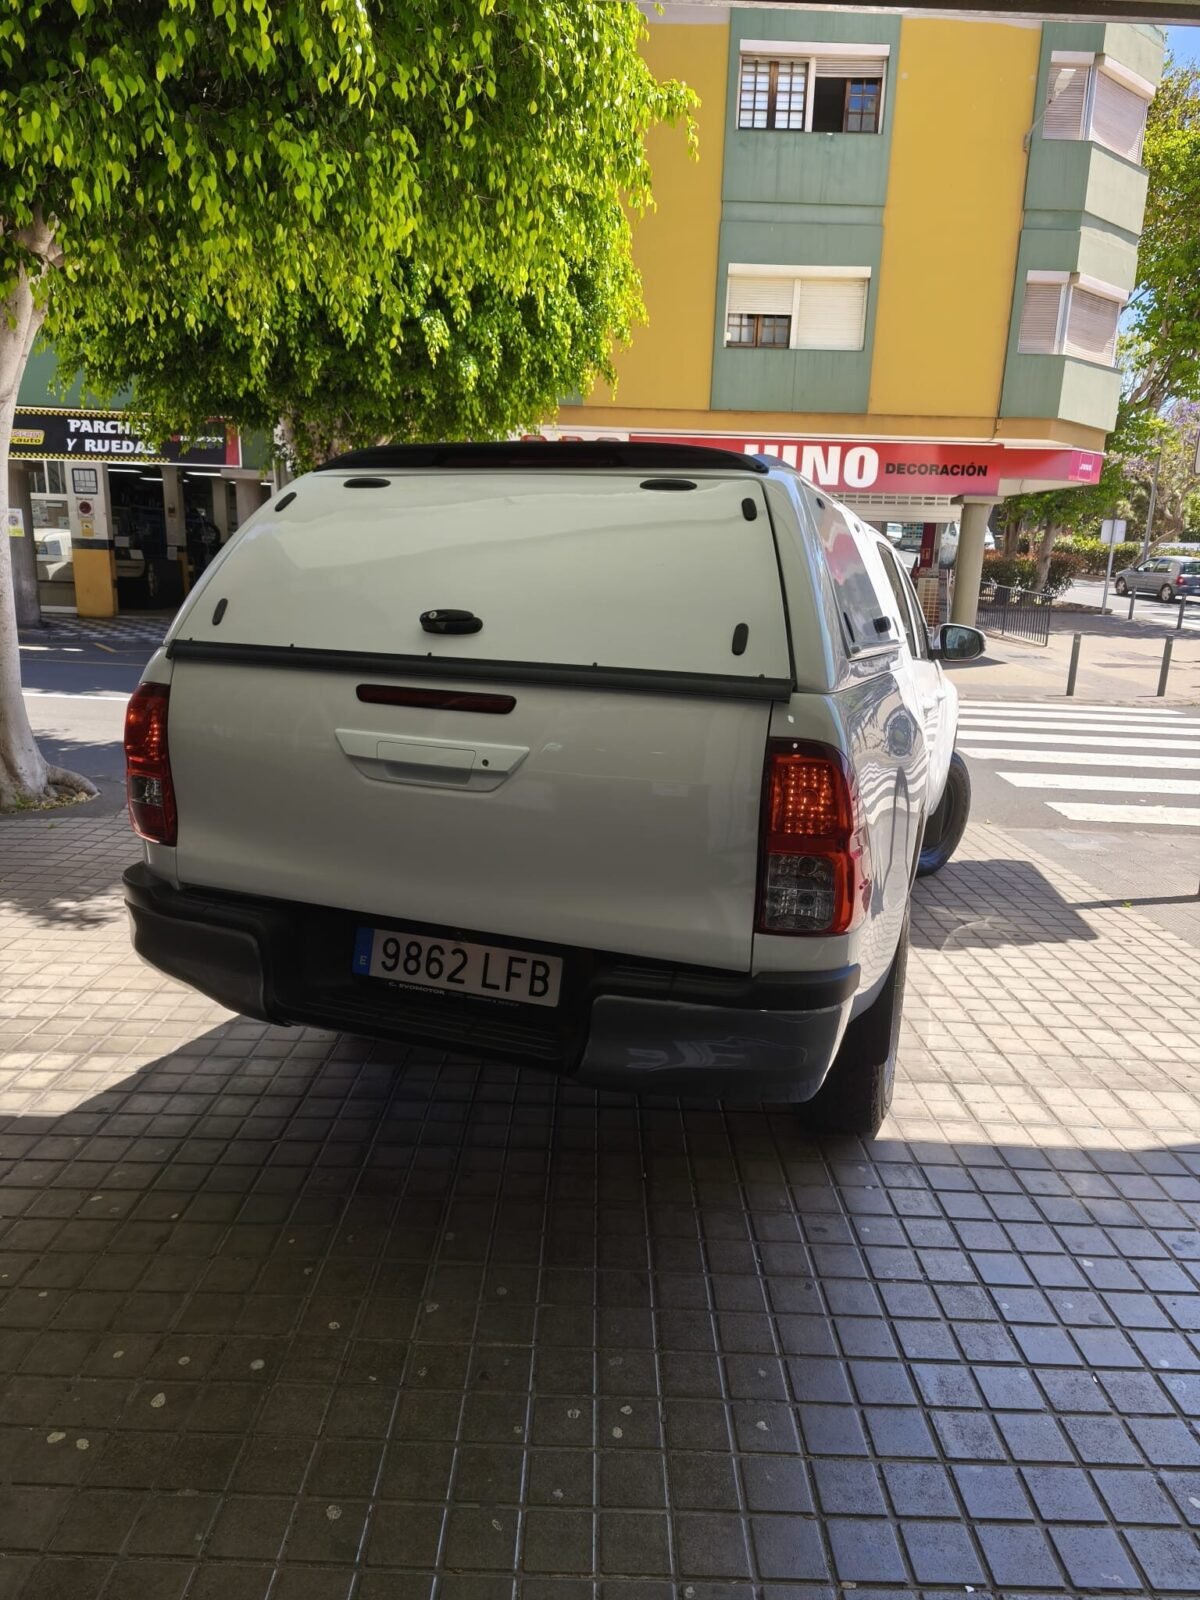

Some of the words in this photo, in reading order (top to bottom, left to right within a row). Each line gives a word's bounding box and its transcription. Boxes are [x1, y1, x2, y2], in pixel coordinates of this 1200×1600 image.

[66, 438, 77, 451] Y
[84, 439, 157, 454] RUEDAS
[744, 444, 880, 489] NO
[885, 462, 988, 477] DECORACIÓN
[359, 955, 368, 966] E
[381, 937, 469, 985] 9862
[481, 952, 551, 998] LFB
